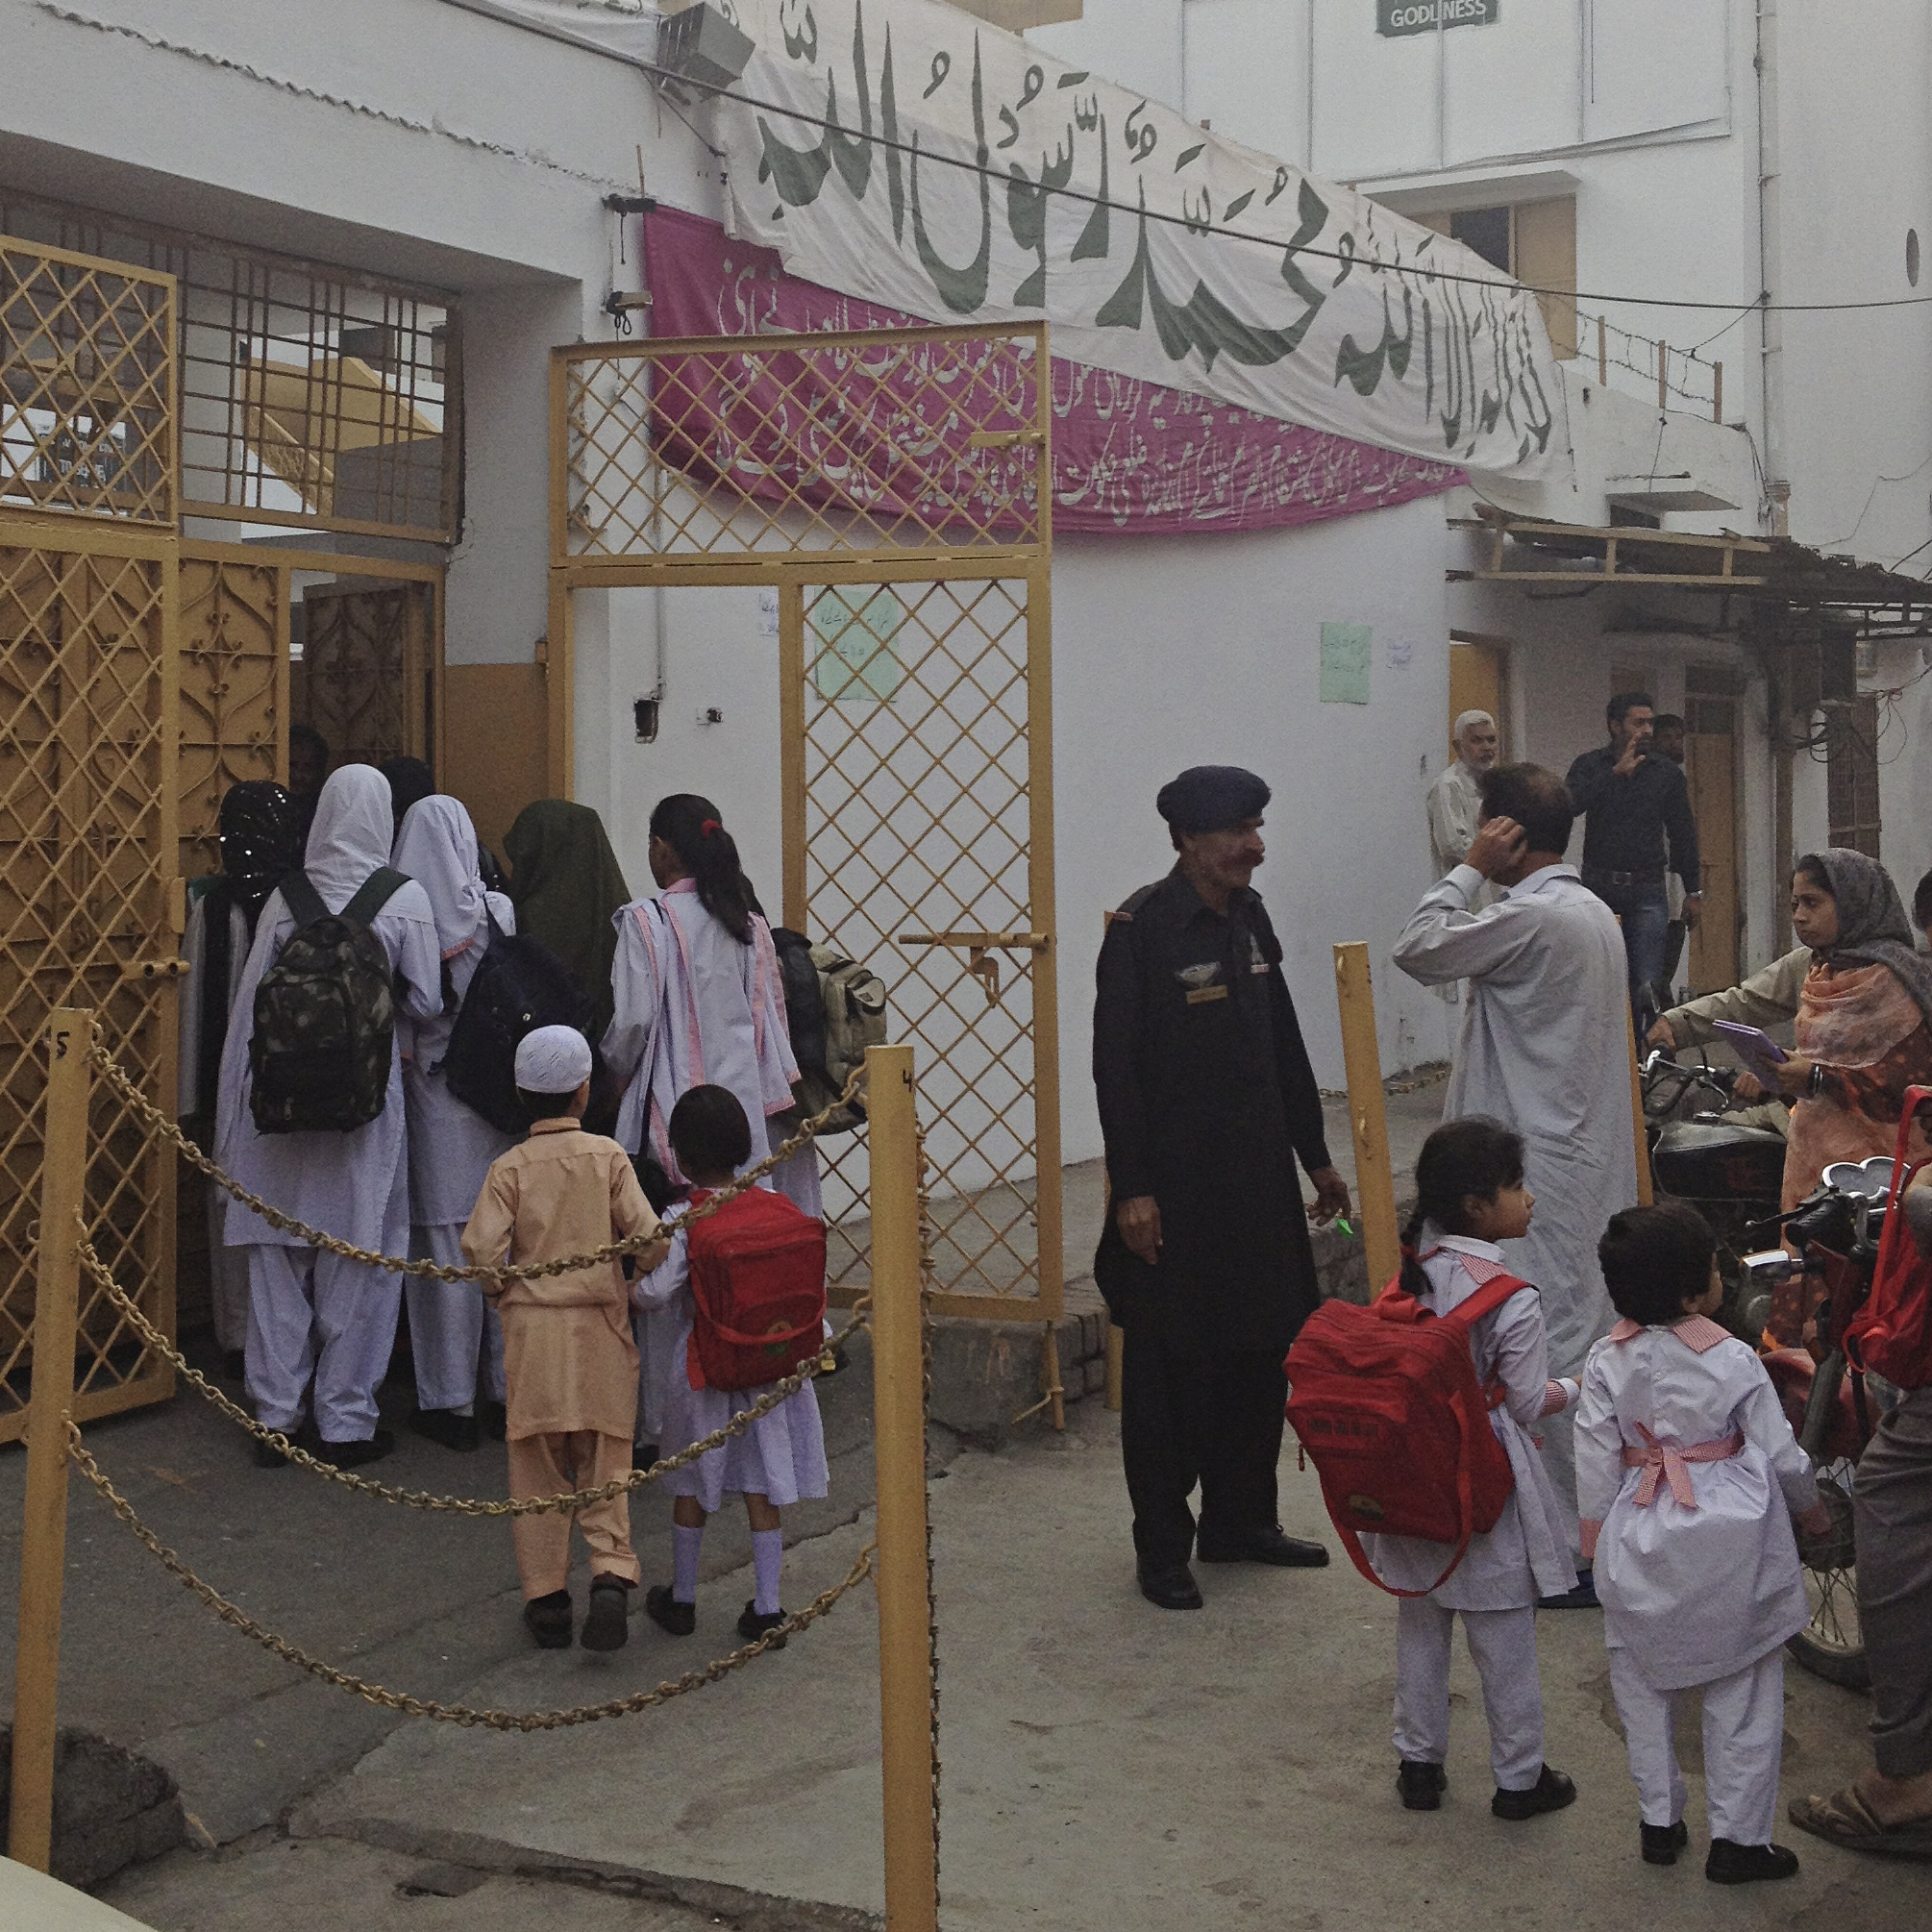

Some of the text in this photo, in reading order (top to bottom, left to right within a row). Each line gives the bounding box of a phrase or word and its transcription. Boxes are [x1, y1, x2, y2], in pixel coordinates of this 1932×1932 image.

[1391, 0, 1487, 28] GODLNESS
[56, 1030, 70, 1060] 5
[902, 1068, 913, 1094] 4
